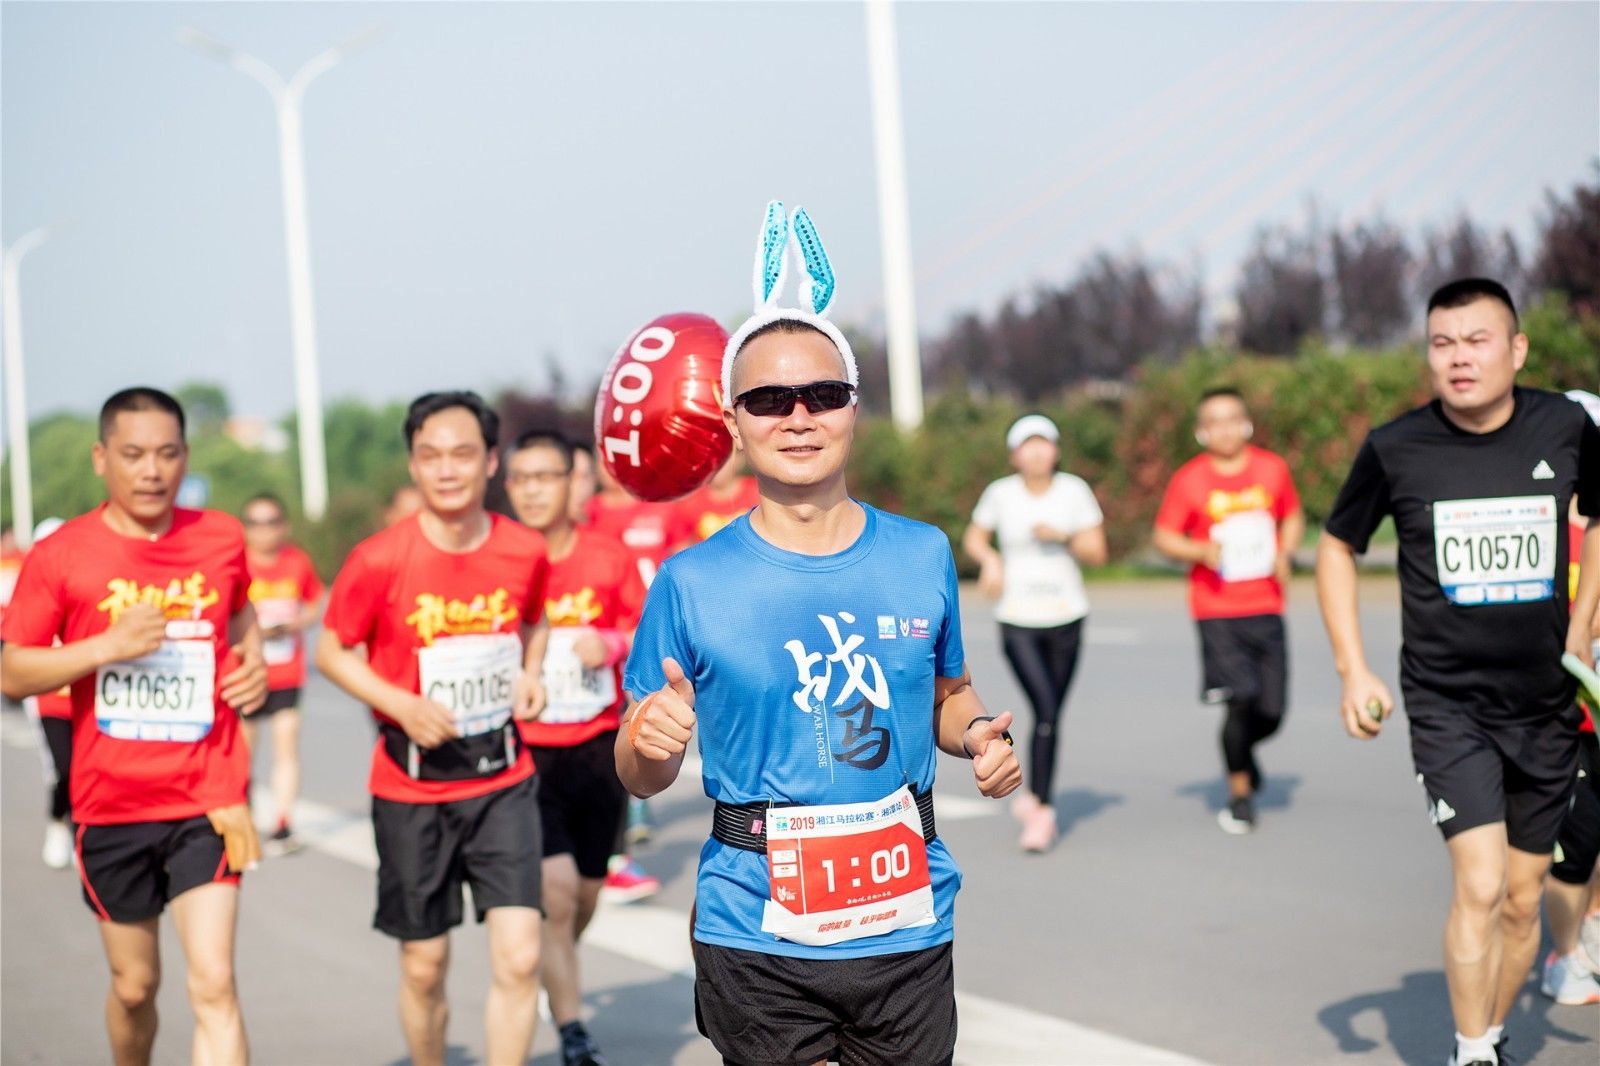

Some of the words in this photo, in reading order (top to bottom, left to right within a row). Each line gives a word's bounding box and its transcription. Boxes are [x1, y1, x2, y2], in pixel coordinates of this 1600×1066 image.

[604, 326, 676, 467] 1:00
[1443, 533, 1540, 573] C10570
[101, 670, 196, 711] C10637
[812, 703, 823, 730] WAR
[815, 730, 828, 769] HORSE
[790, 816, 815, 831] 2019
